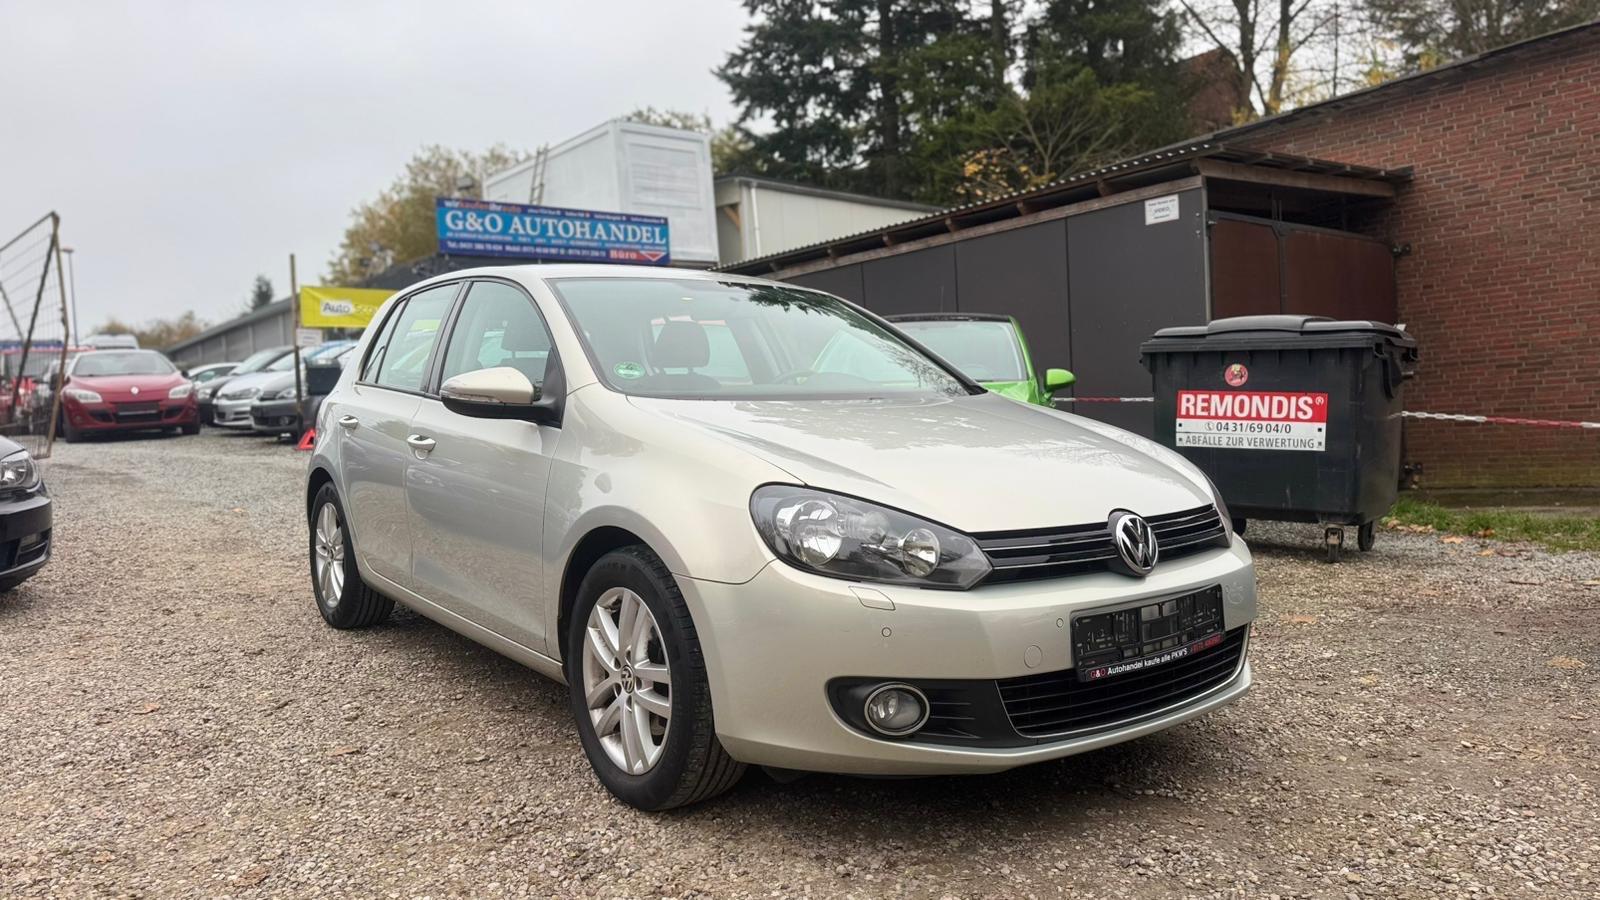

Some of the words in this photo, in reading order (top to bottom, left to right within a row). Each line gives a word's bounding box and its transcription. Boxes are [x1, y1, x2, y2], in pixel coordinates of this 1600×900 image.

[445, 209, 504, 233] G&O
[509, 215, 667, 244] AUTOHANDEL
[609, 249, 638, 260] Büro
[323, 302, 351, 313] Auto
[1226, 436, 1244, 447] ZUR
[1246, 437, 1315, 449] VERWERTUNG
[1107, 661, 1144, 676] Autohandel
[1144, 656, 1161, 669] kaufe
[1160, 653, 1171, 665] alle
